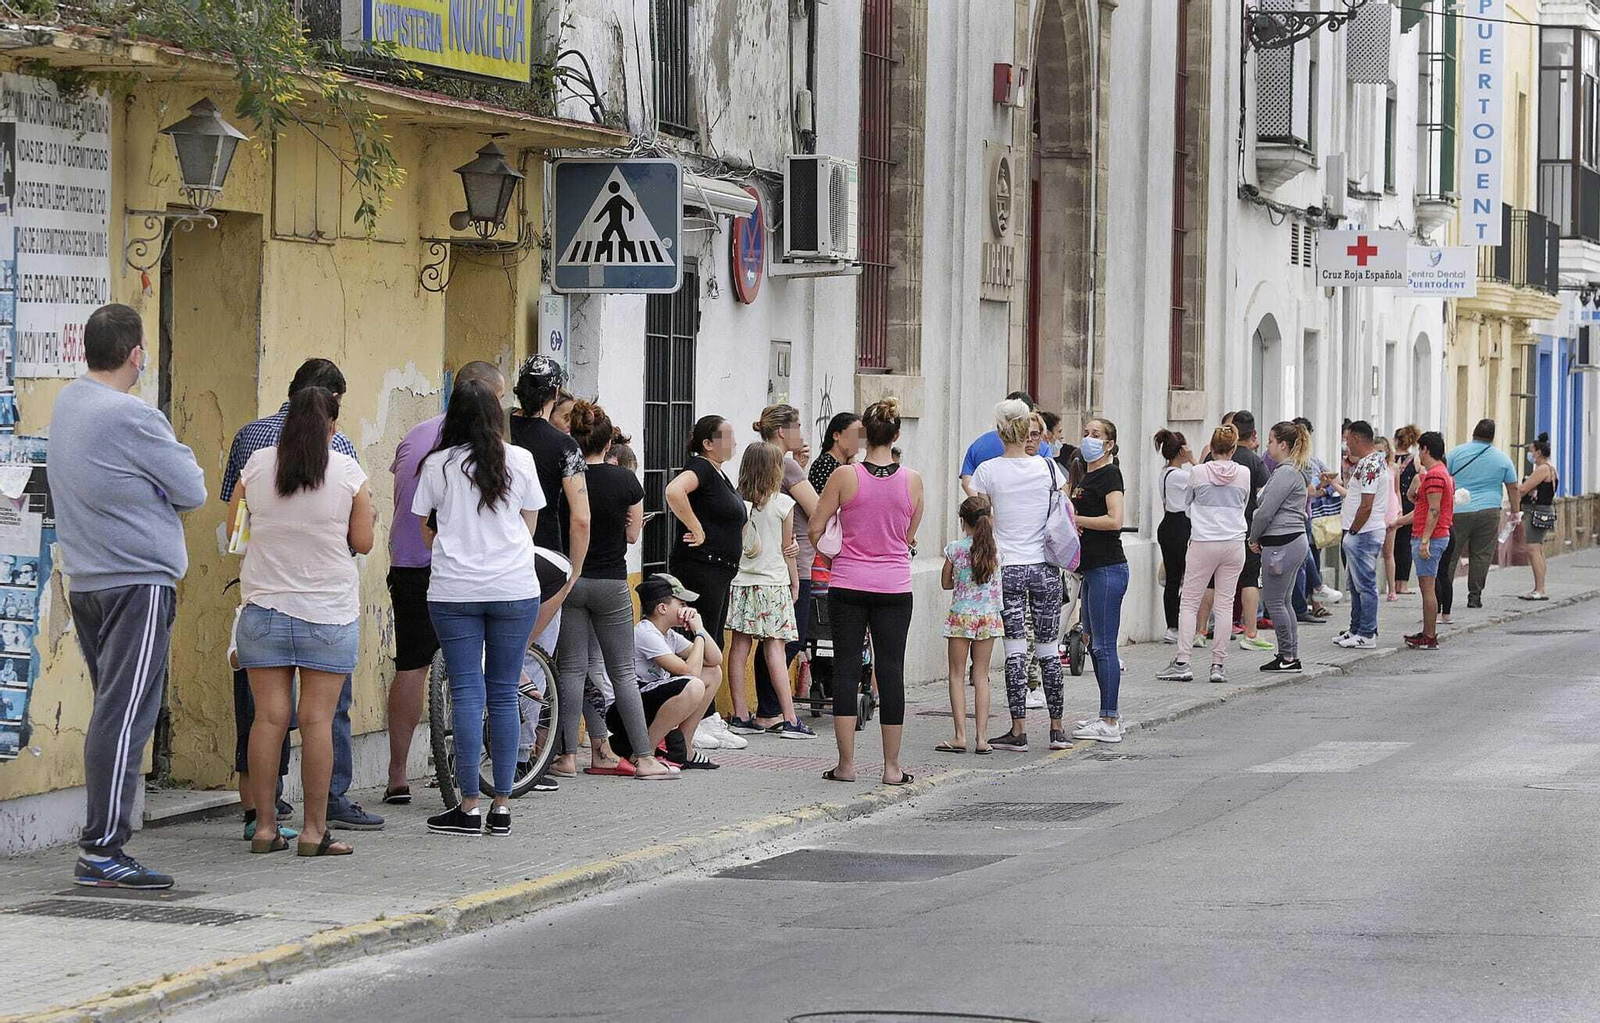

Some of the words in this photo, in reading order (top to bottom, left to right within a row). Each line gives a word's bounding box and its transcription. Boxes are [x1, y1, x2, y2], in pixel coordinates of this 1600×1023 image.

[374, 2, 444, 54] COPISTERIA
[450, 0, 526, 64] NORIEGA
[1473, 0, 1495, 239] PUERTODENT
[35, 140, 44, 164] DE
[67, 145, 108, 171] DORMITORIOS
[34, 274, 43, 304] DE
[44, 274, 70, 304] COCINA
[70, 276, 79, 305] DE
[80, 276, 107, 306] REGALO
[1322, 270, 1342, 280] Cruz
[1344, 270, 1364, 282] Roja
[1365, 269, 1403, 282] Española
[1437, 270, 1466, 278] Dental
[63, 323, 77, 363] 956
